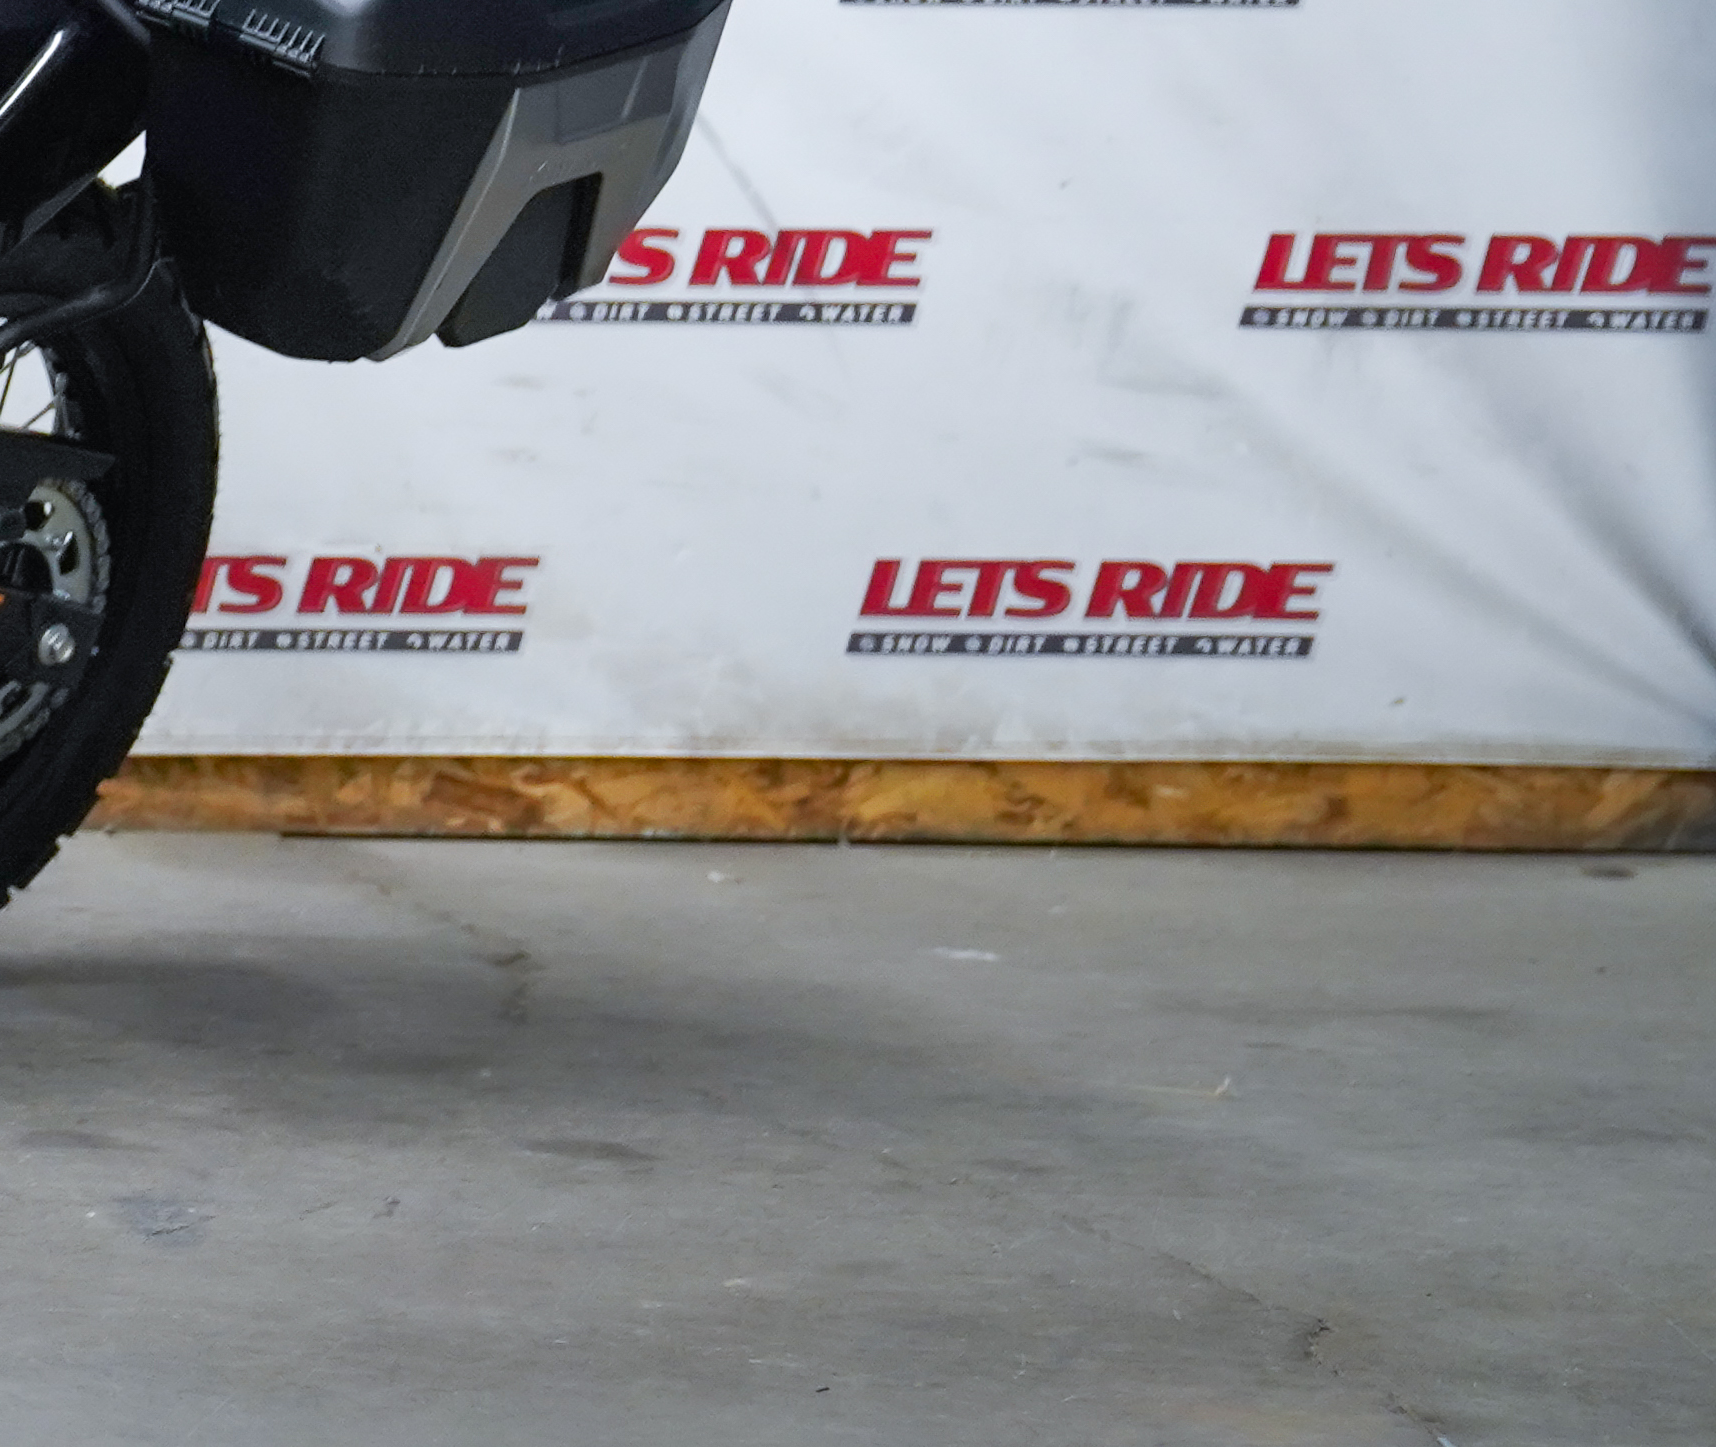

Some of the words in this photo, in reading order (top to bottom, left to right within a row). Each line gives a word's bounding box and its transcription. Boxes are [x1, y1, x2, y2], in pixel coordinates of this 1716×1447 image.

[687, 229, 932, 287] RIDE
[1255, 234, 1464, 291] LETS
[1478, 236, 1716, 292] RIDE
[187, 555, 287, 614] TS
[296, 556, 540, 615] RIDE
[861, 560, 1074, 617] LETS
[1087, 561, 1332, 619] RIDE
